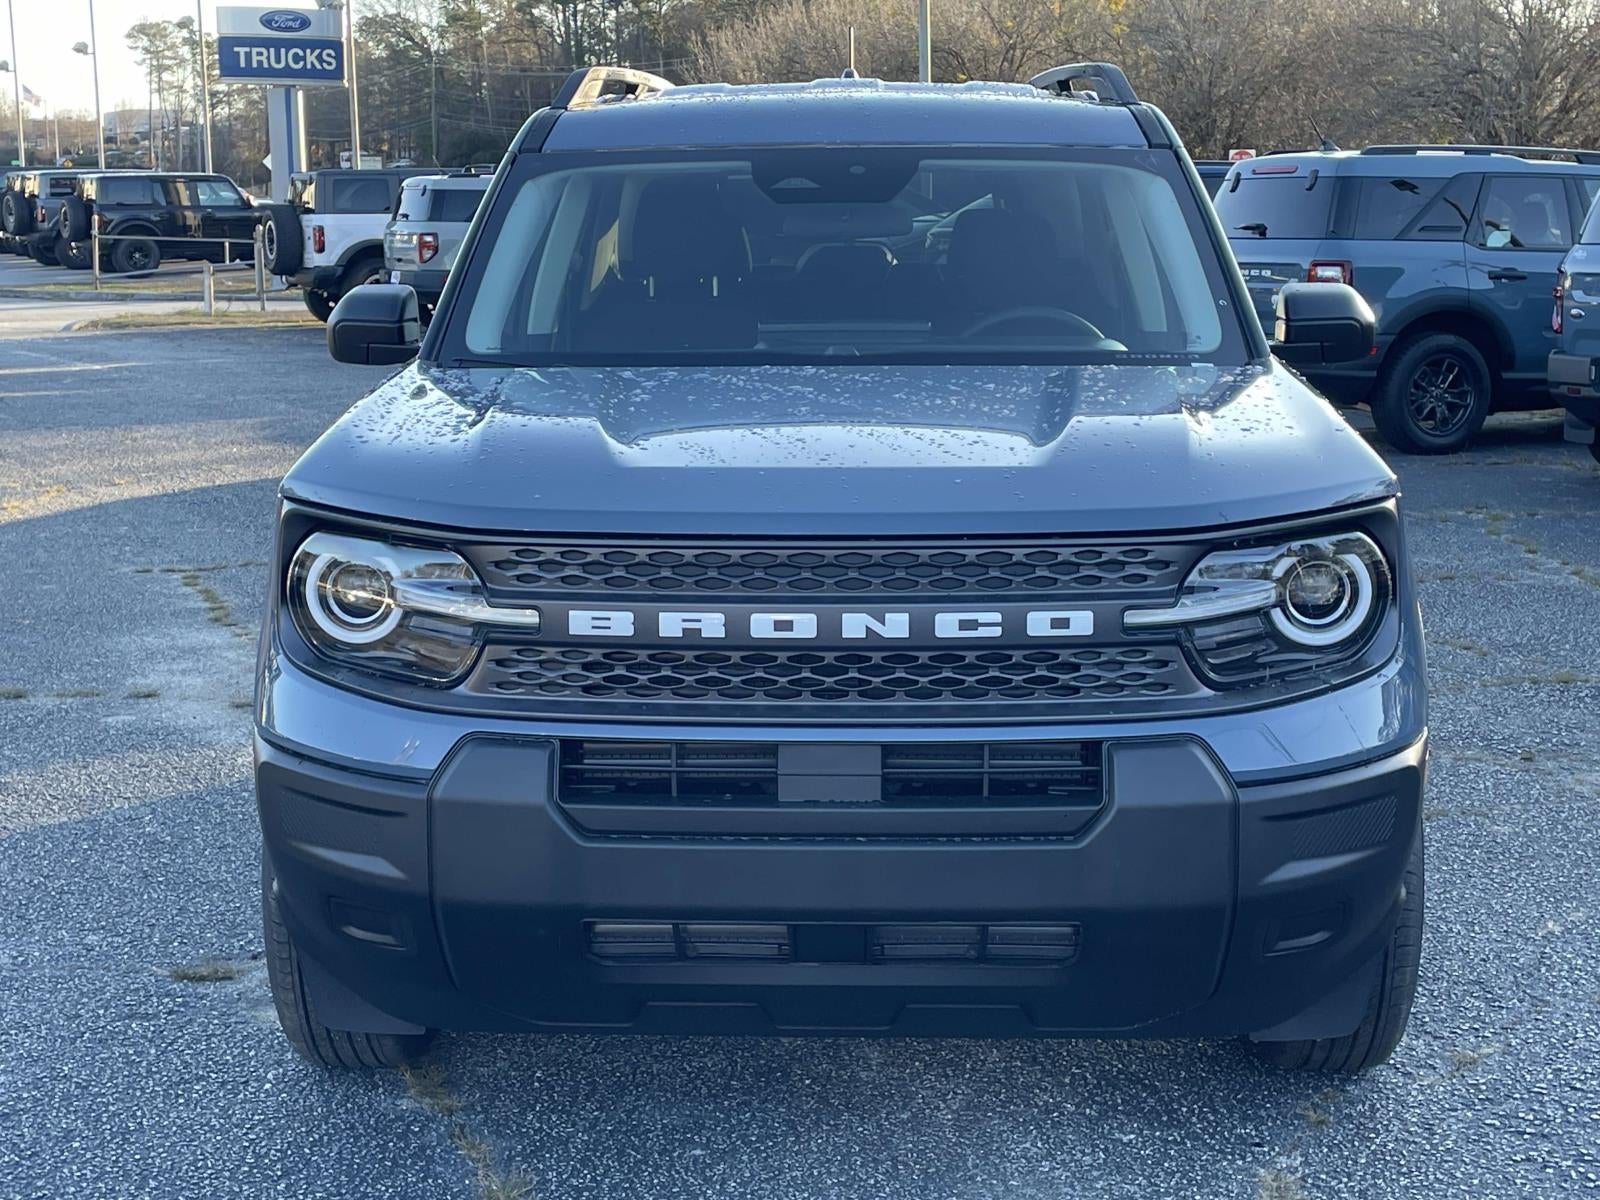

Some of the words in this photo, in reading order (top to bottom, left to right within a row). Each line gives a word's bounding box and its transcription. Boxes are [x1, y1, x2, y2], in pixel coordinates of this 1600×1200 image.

[271, 14, 301, 29] Ford
[233, 46, 337, 70] TRUCKS
[567, 609, 1095, 639] BRONCO
